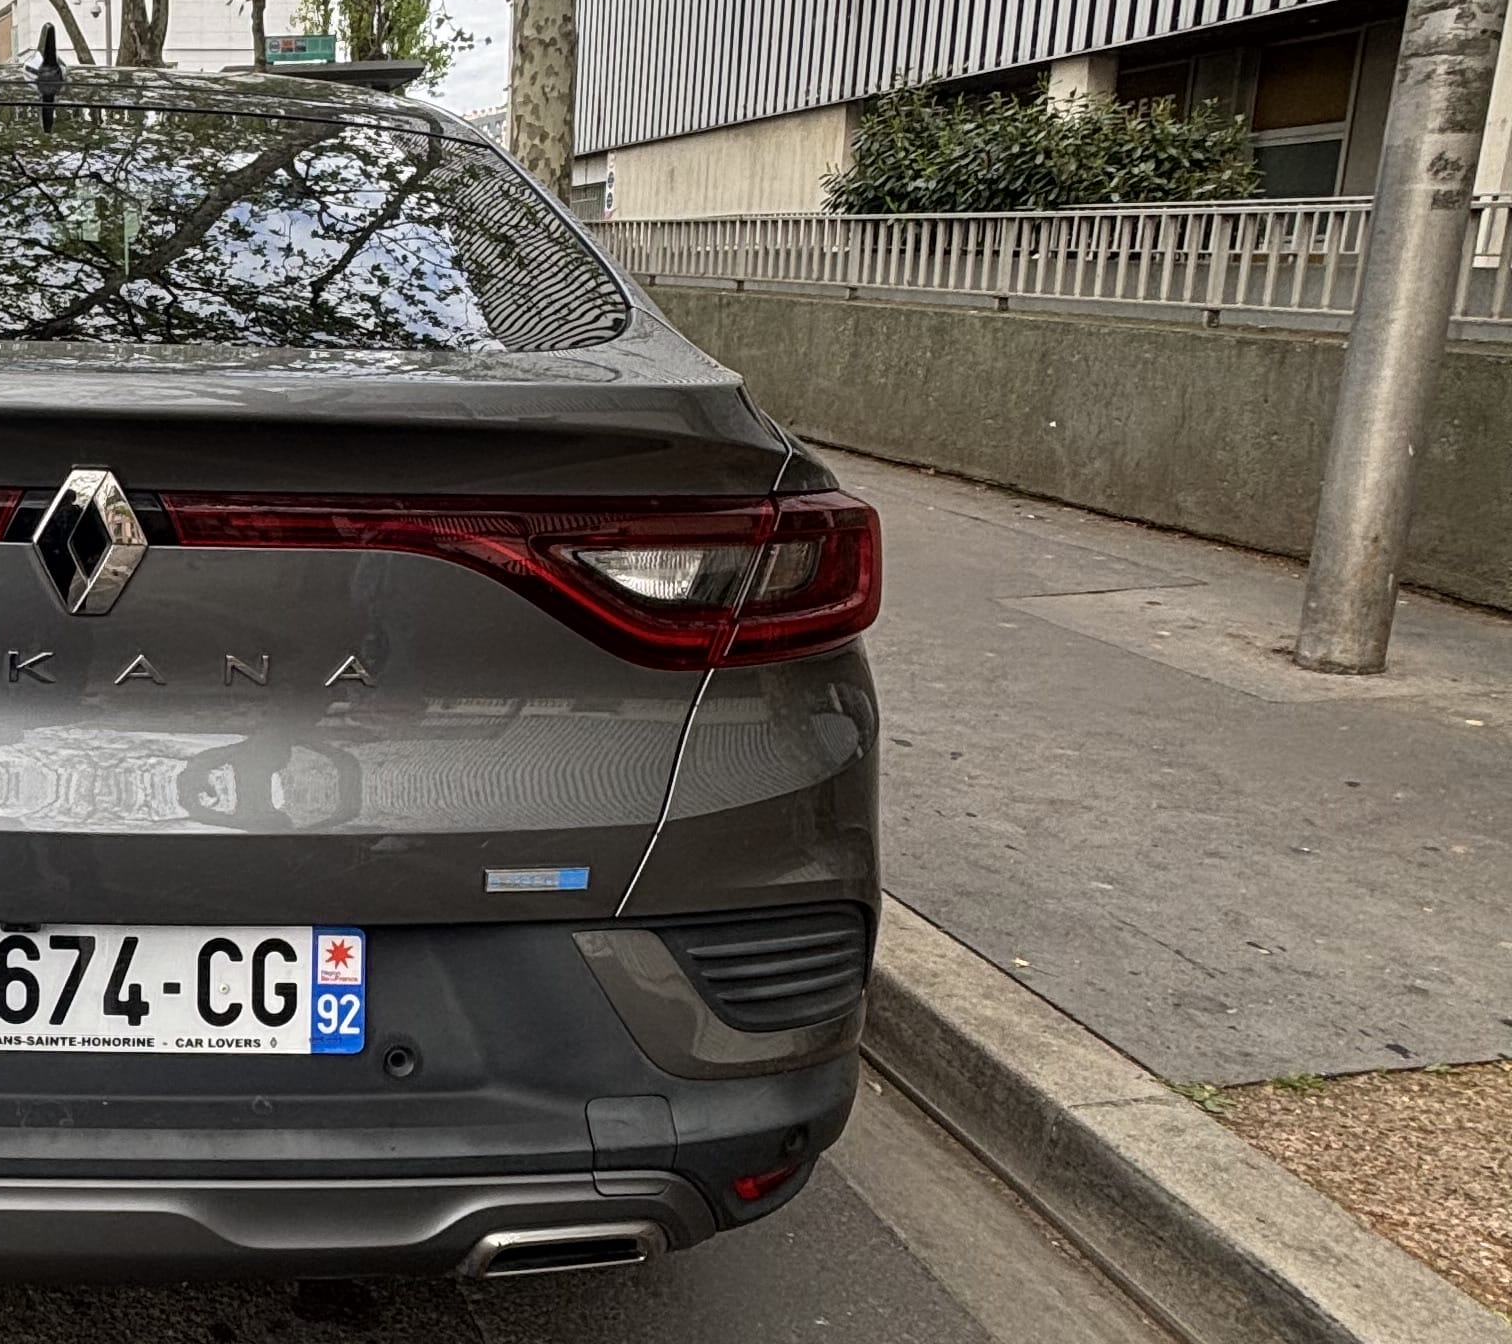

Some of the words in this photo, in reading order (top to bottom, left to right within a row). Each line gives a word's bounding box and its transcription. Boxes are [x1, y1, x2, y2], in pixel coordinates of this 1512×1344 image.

[317, 993, 361, 1035] 92
[175, 1038, 203, 1048] CAR
[208, 1038, 261, 1048] LOVERS
